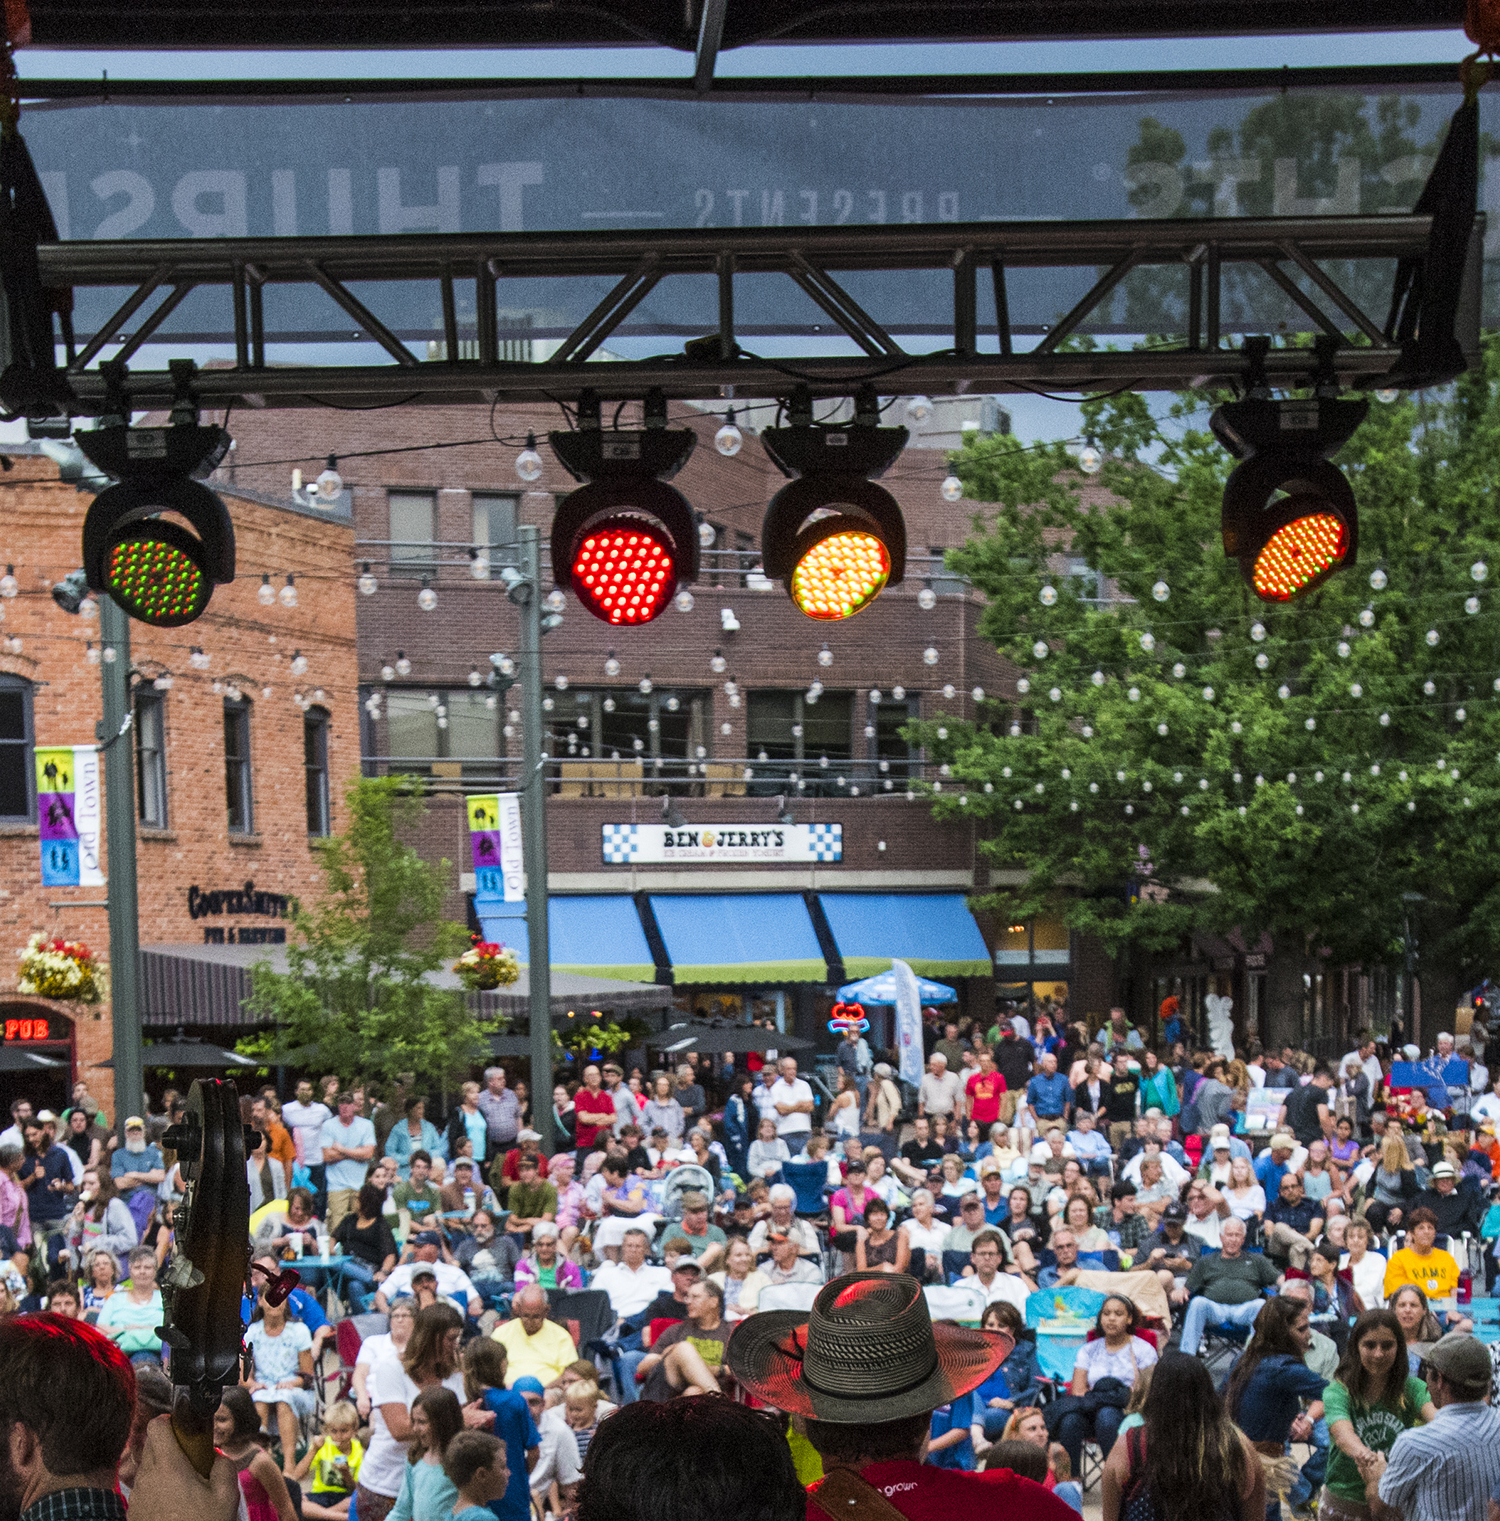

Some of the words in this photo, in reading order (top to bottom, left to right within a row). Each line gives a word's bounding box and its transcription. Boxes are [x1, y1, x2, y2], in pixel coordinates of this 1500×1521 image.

[663, 831, 698, 847] BEN
[702, 831, 715, 848] &
[716, 829, 784, 847] JERRY'S
[5, 1019, 49, 1040] PUB
[1412, 1267, 1447, 1279] RAMS
